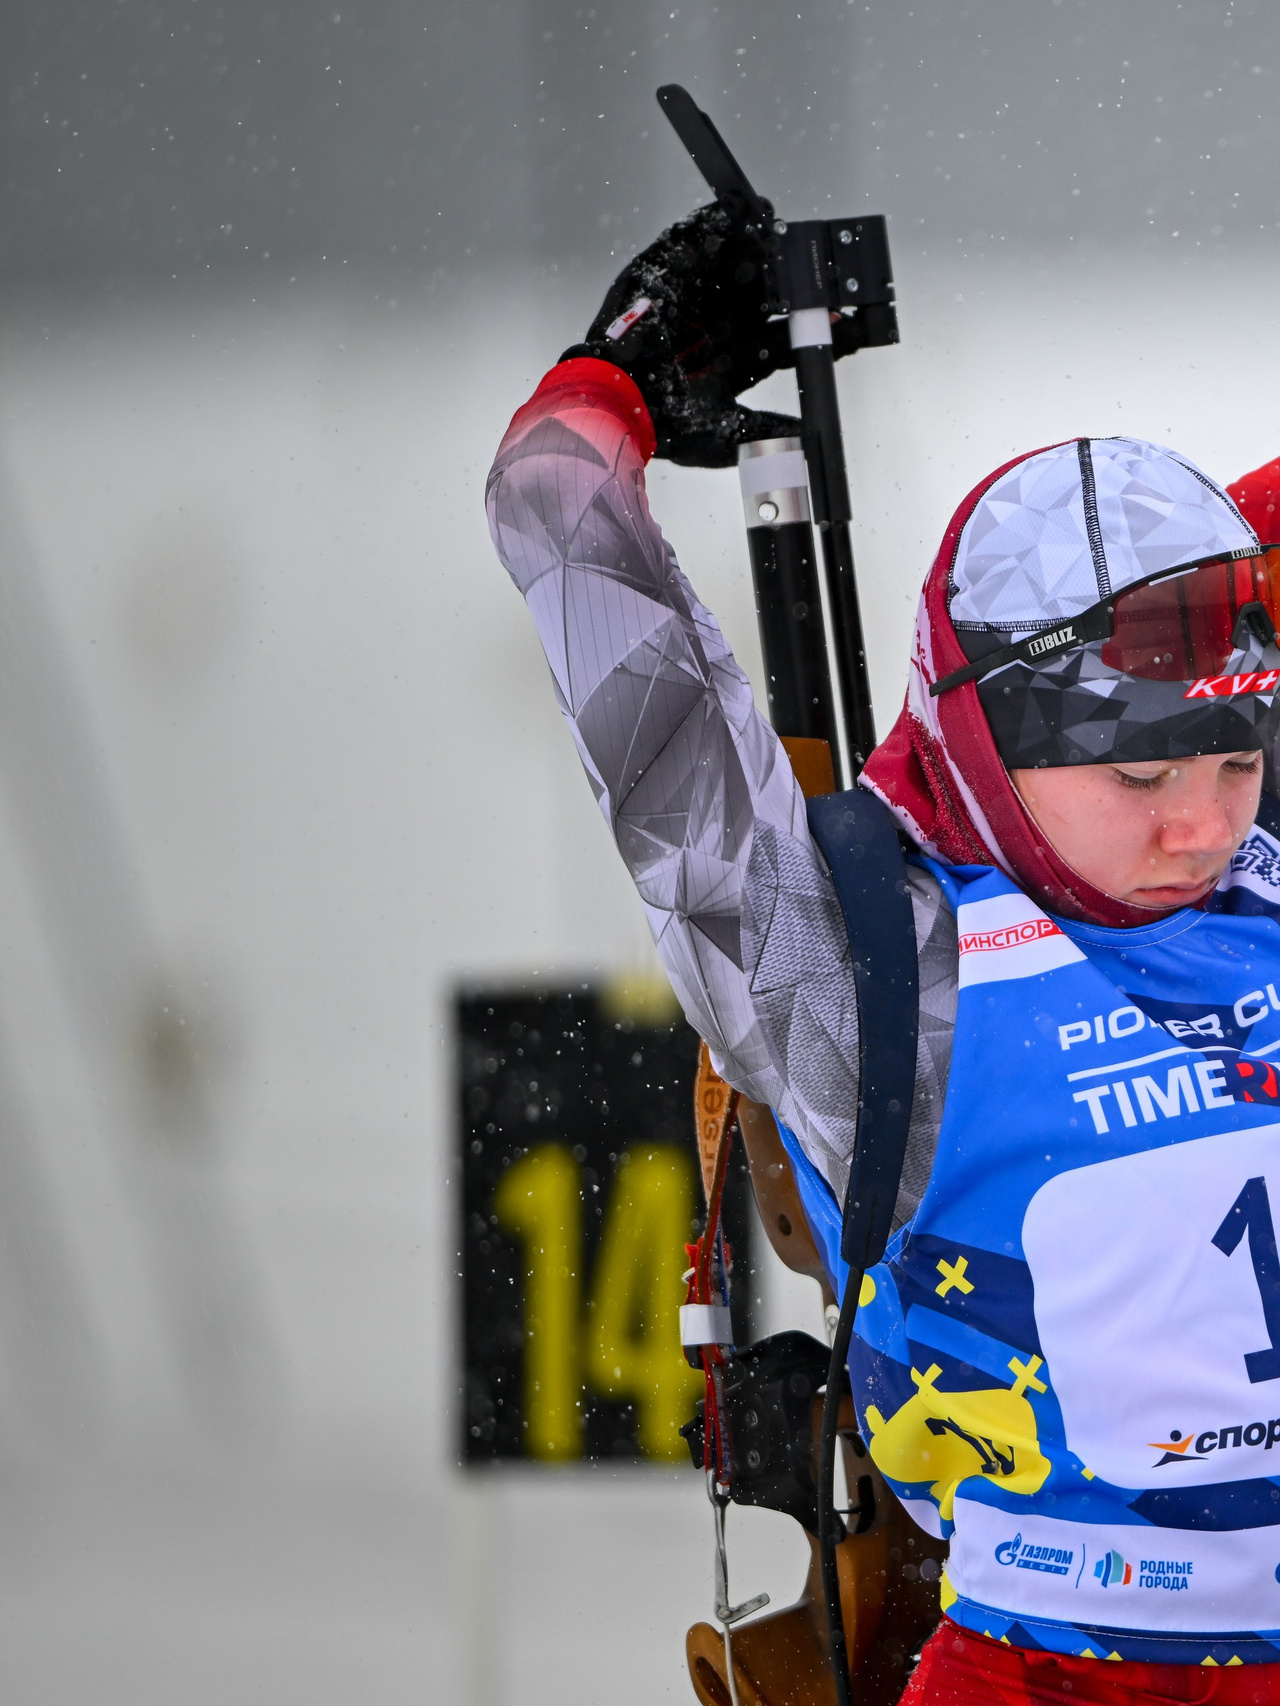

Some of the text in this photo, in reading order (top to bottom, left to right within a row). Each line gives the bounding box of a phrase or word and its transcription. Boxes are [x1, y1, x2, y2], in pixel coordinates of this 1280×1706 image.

[811, 240, 822, 289] ПИОНЕР
[1242, 546, 1263, 557] BLIZ
[1043, 625, 1077, 650] BLIZ
[1186, 670, 1278, 698] KV+
[959, 921, 1062, 952] ИНСПОР
[1058, 1003, 1225, 1051] PIOER
[498, 1145, 702, 1462] 14
[1020, 1544, 1074, 1565] ГАЗПРОМ
[1140, 1560, 1193, 1575] РОДНЫЕ
[1139, 1575, 1189, 1591] ГОРОДА
